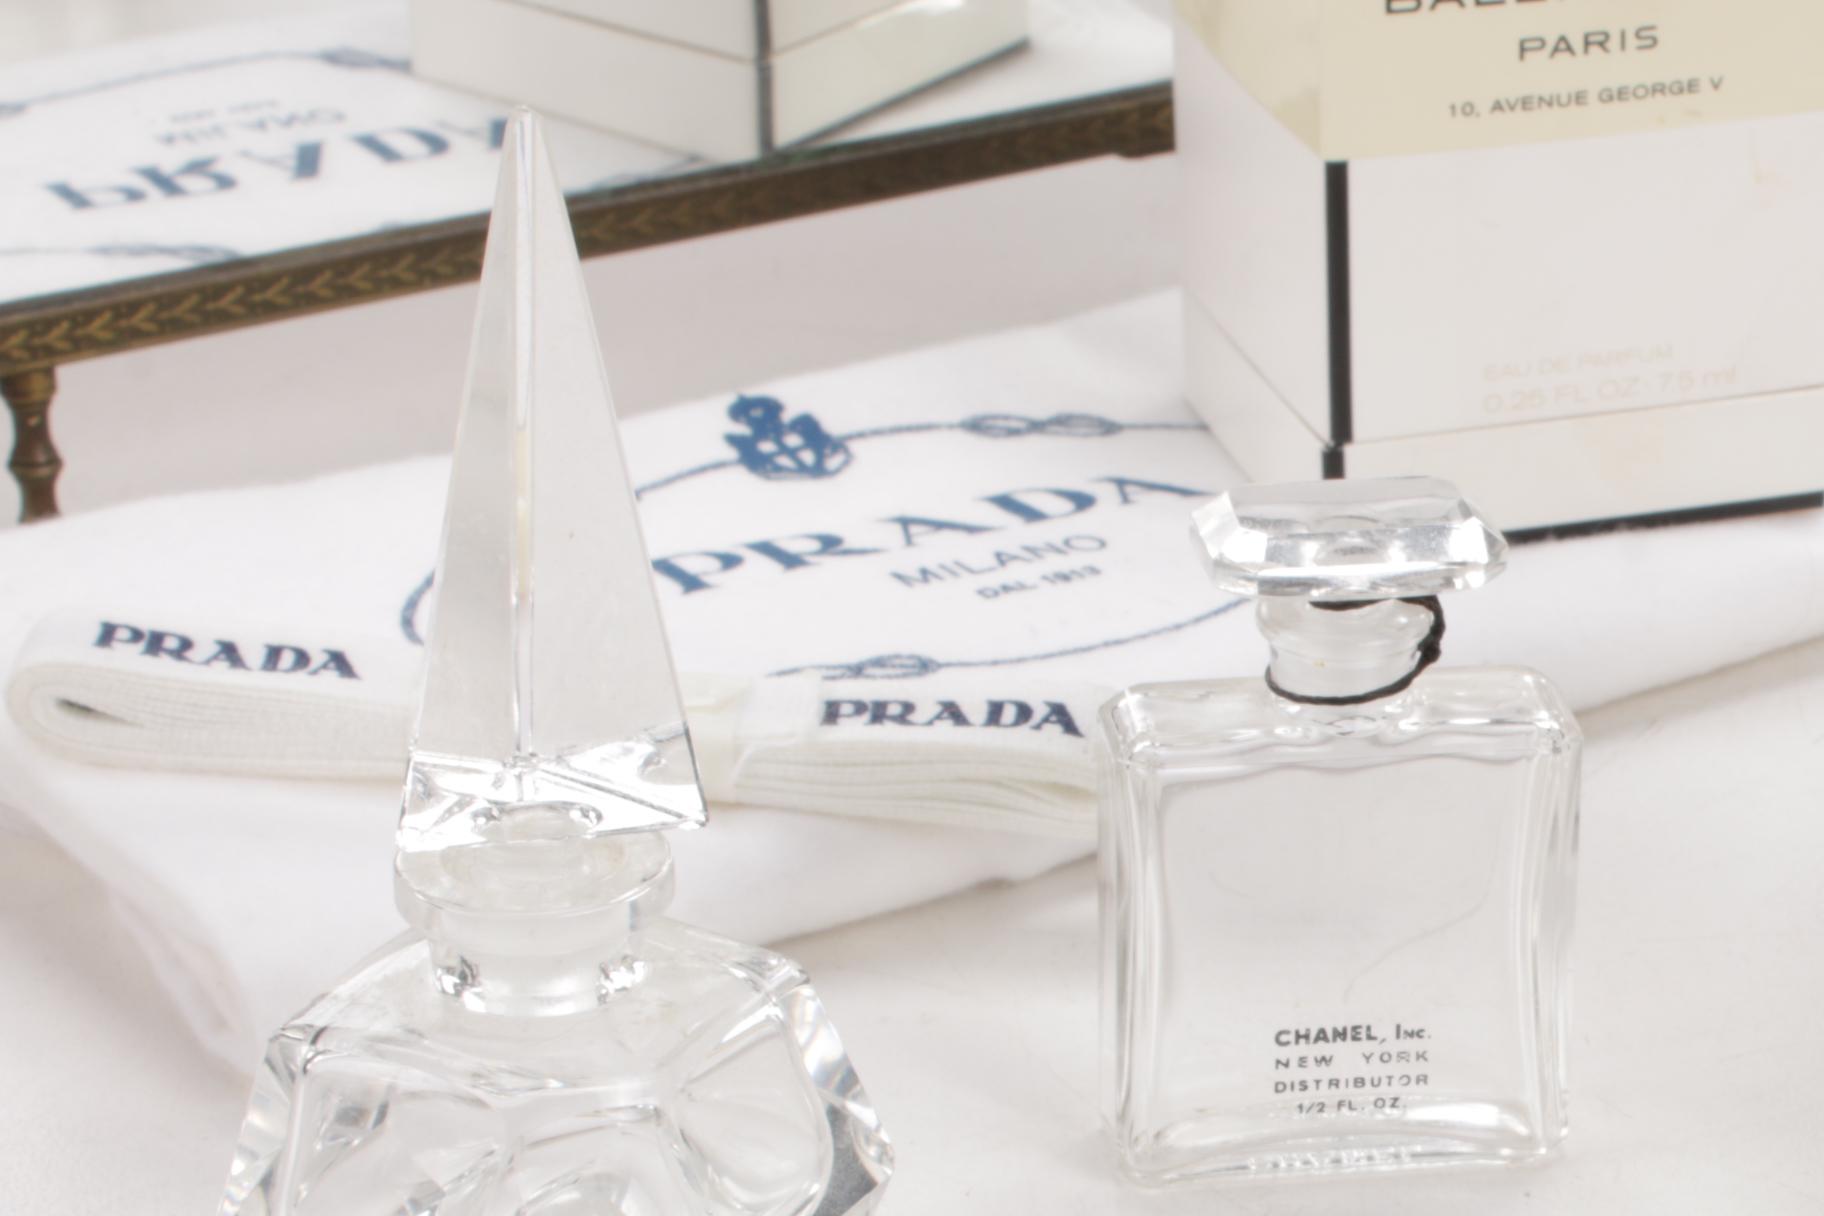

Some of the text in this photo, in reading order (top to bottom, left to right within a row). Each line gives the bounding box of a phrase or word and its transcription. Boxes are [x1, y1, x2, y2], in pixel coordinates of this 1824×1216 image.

[1518, 26, 1659, 61] PARIS
[1448, 76, 1724, 118] 10, AVENUE GEORGE V
[651, 476, 1218, 594] PRADA
[890, 535, 1107, 588] MILANO
[91, 620, 362, 681] PRADA
[818, 699, 1084, 738] PRADA
[1274, 1025, 1387, 1046] CHANEL,
[1275, 1050, 1429, 1070] NEW YORK
[1274, 1074, 1429, 1094] DISTRIBUTOR
[1297, 1102, 1326, 1114] 1/2
[1337, 1100, 1366, 1112] FL.
